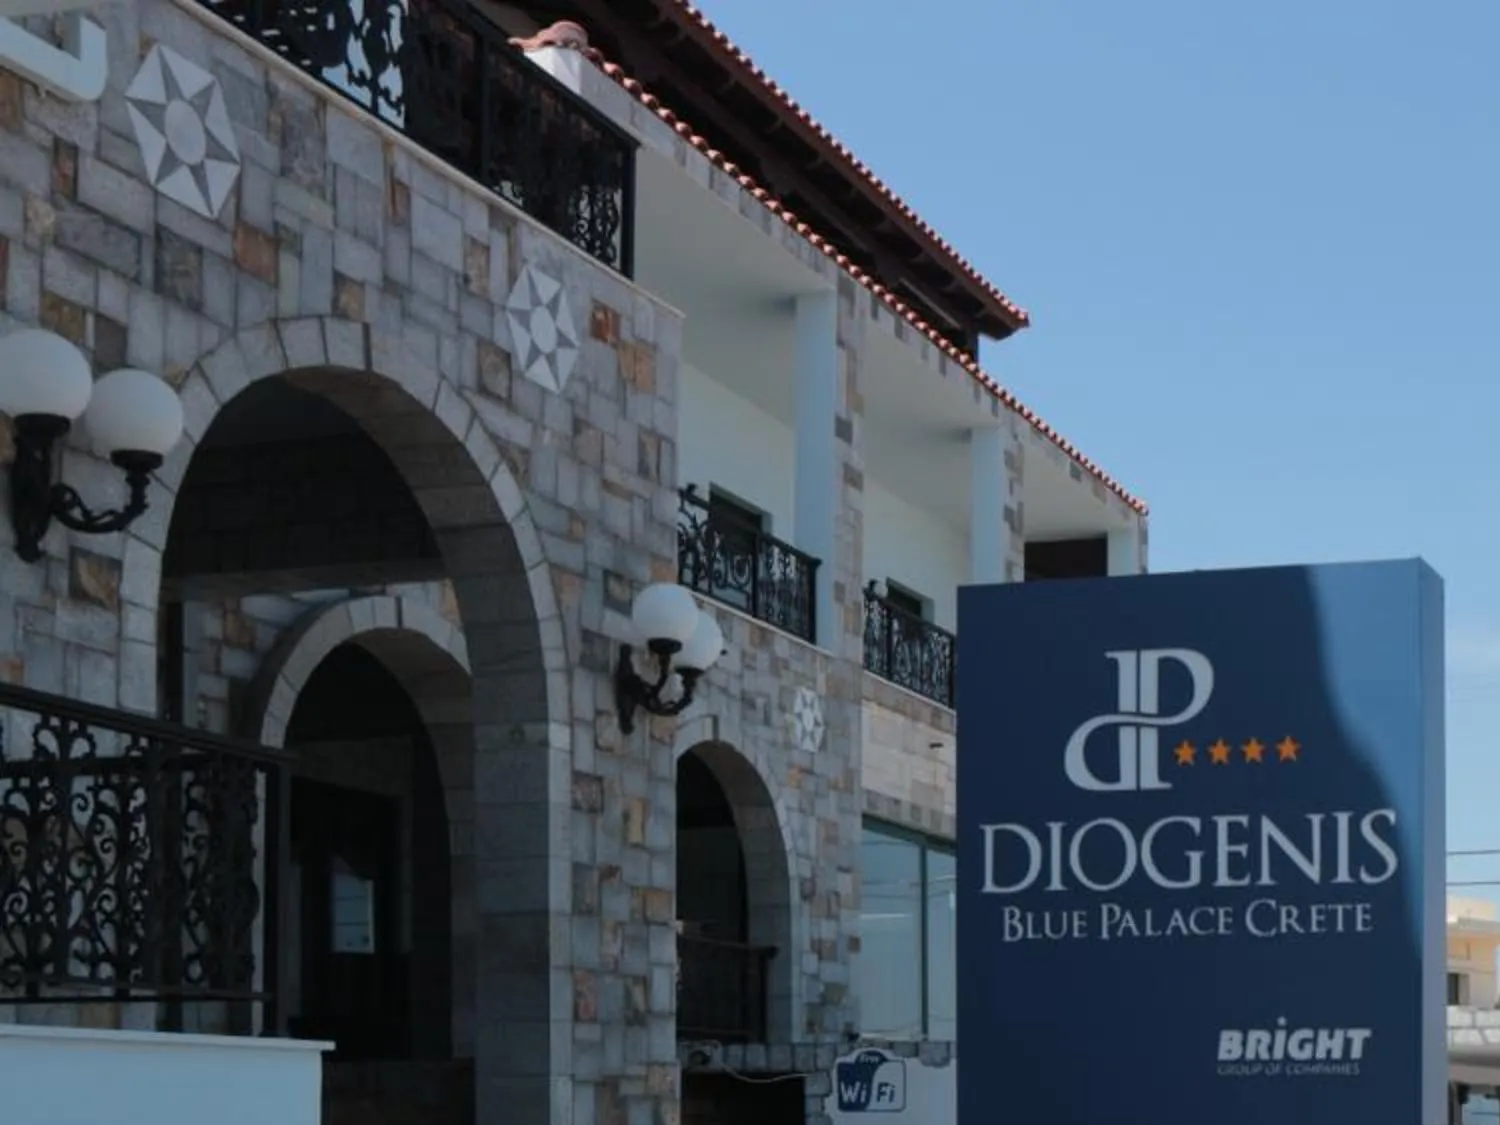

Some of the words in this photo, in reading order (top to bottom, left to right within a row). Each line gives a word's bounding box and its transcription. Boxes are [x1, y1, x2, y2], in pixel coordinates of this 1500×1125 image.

[979, 808, 1399, 894] DIOGENIS
[1002, 906, 1088, 942] BLUE
[1100, 903, 1234, 940] PALACE
[1245, 899, 1374, 938] CRETE
[1217, 1063, 1262, 1076] GROUP
[1265, 1063, 1282, 1075] OF
[1286, 1062, 1361, 1076] COMPANIES
